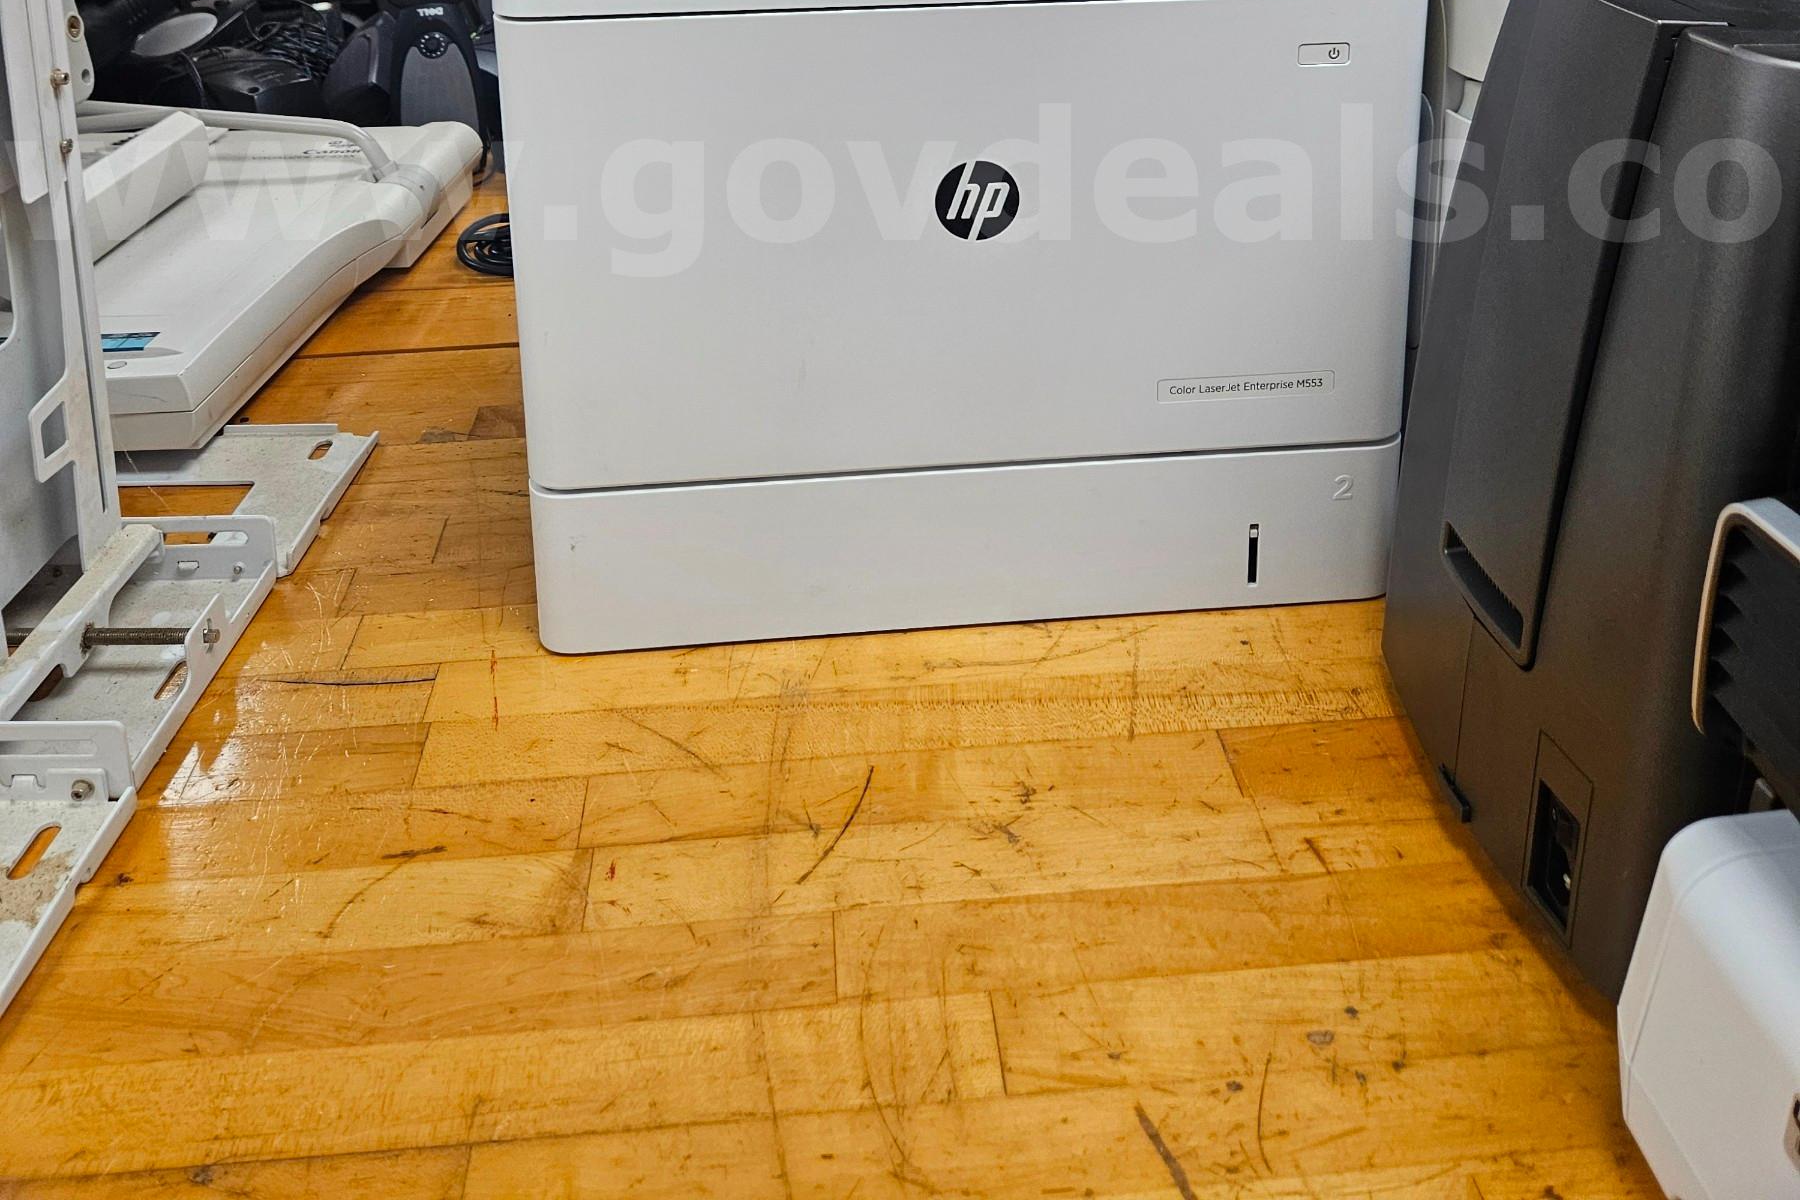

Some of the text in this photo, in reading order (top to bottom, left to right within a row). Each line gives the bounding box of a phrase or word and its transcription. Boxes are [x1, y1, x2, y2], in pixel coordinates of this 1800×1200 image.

[416, 6, 444, 17] DELL
[941, 161, 1014, 241] hp
[1169, 377, 1324, 395] Color LaserJet Enterprise M553
[1331, 474, 1355, 500] 2
